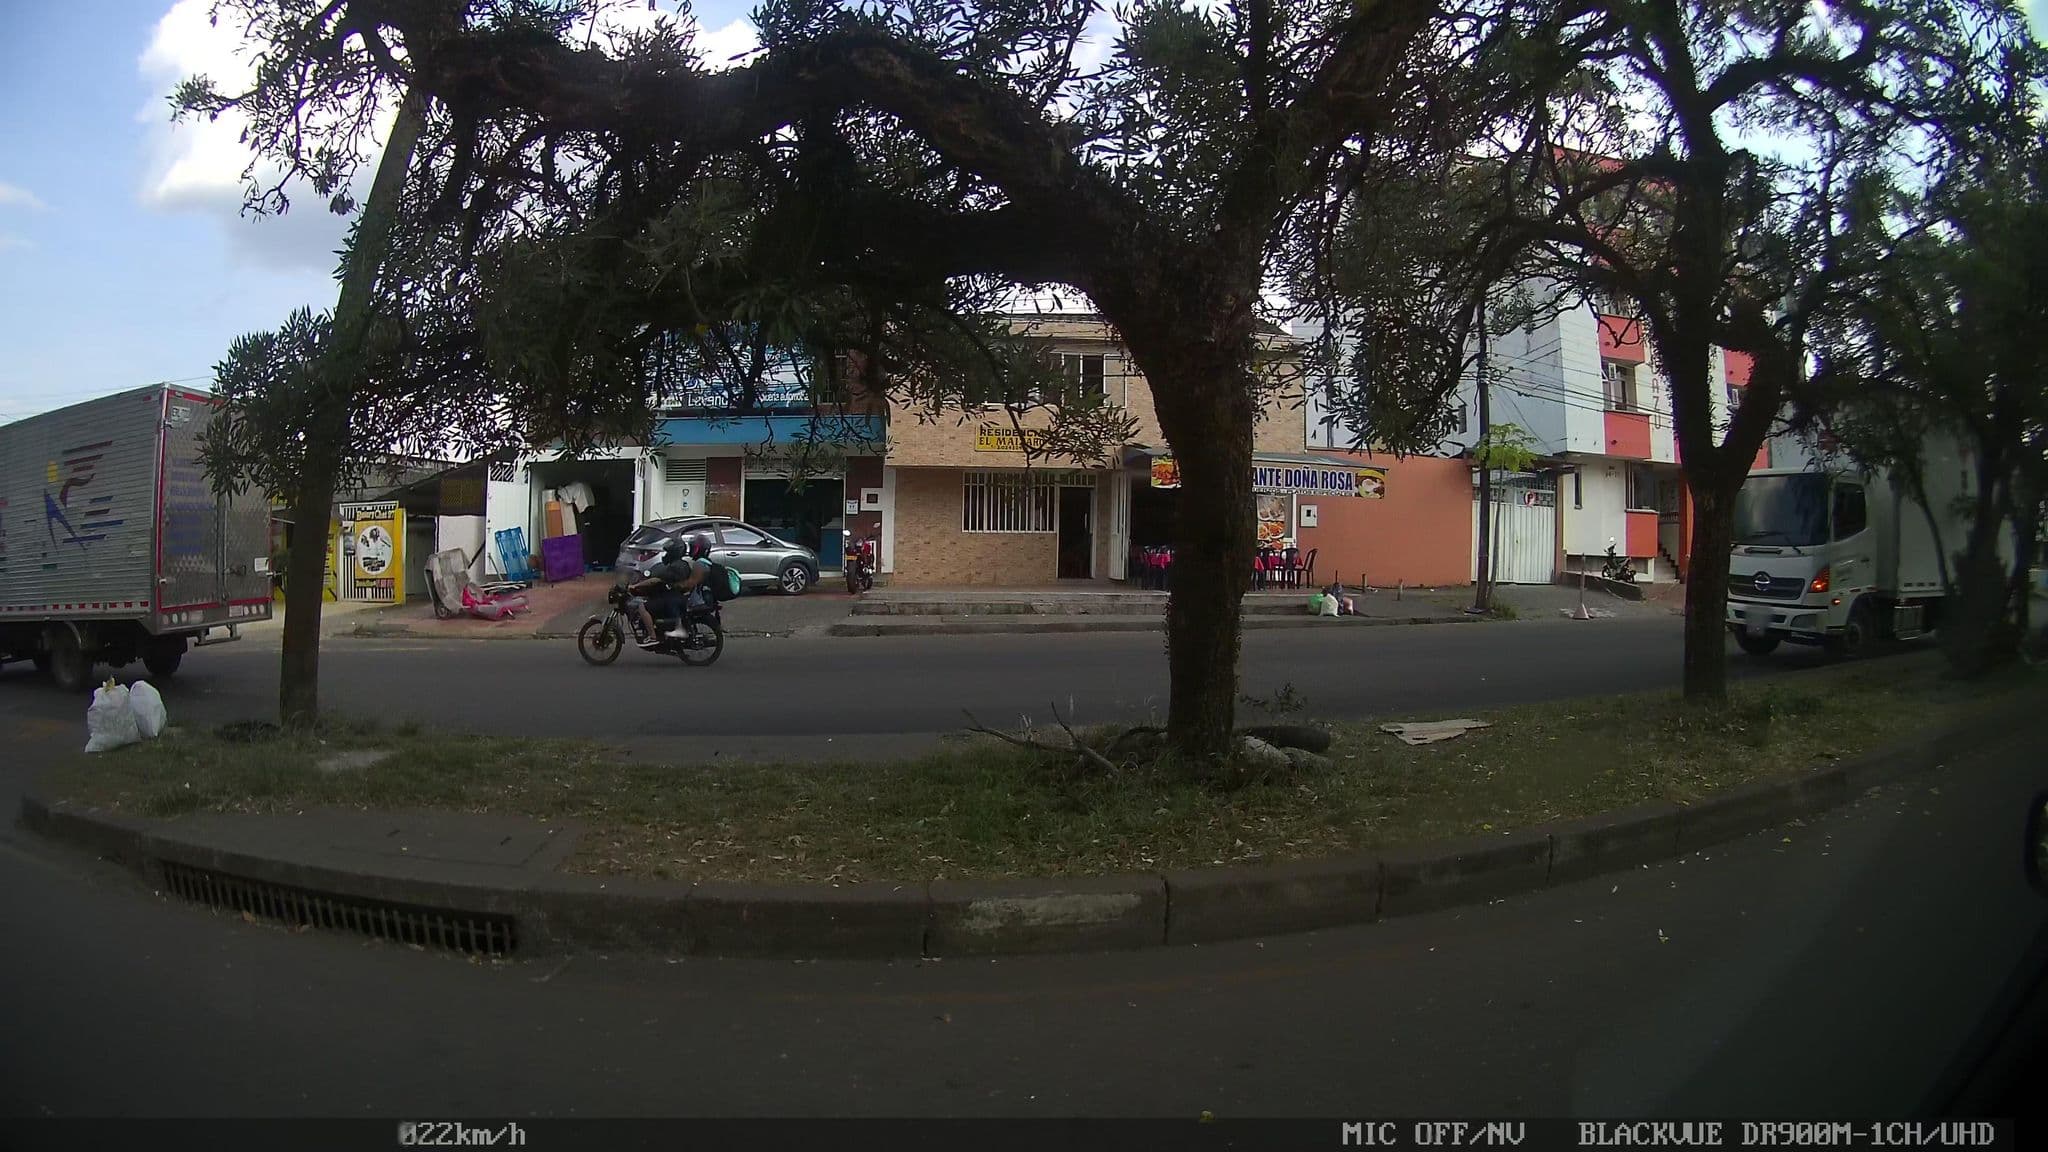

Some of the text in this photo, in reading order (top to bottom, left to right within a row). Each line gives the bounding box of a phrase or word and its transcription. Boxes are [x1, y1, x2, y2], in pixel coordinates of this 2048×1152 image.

[980, 437, 1045, 447] EL MAIARO
[1285, 466, 1318, 488] DOÑA
[1322, 471, 1353, 490] ROSA
